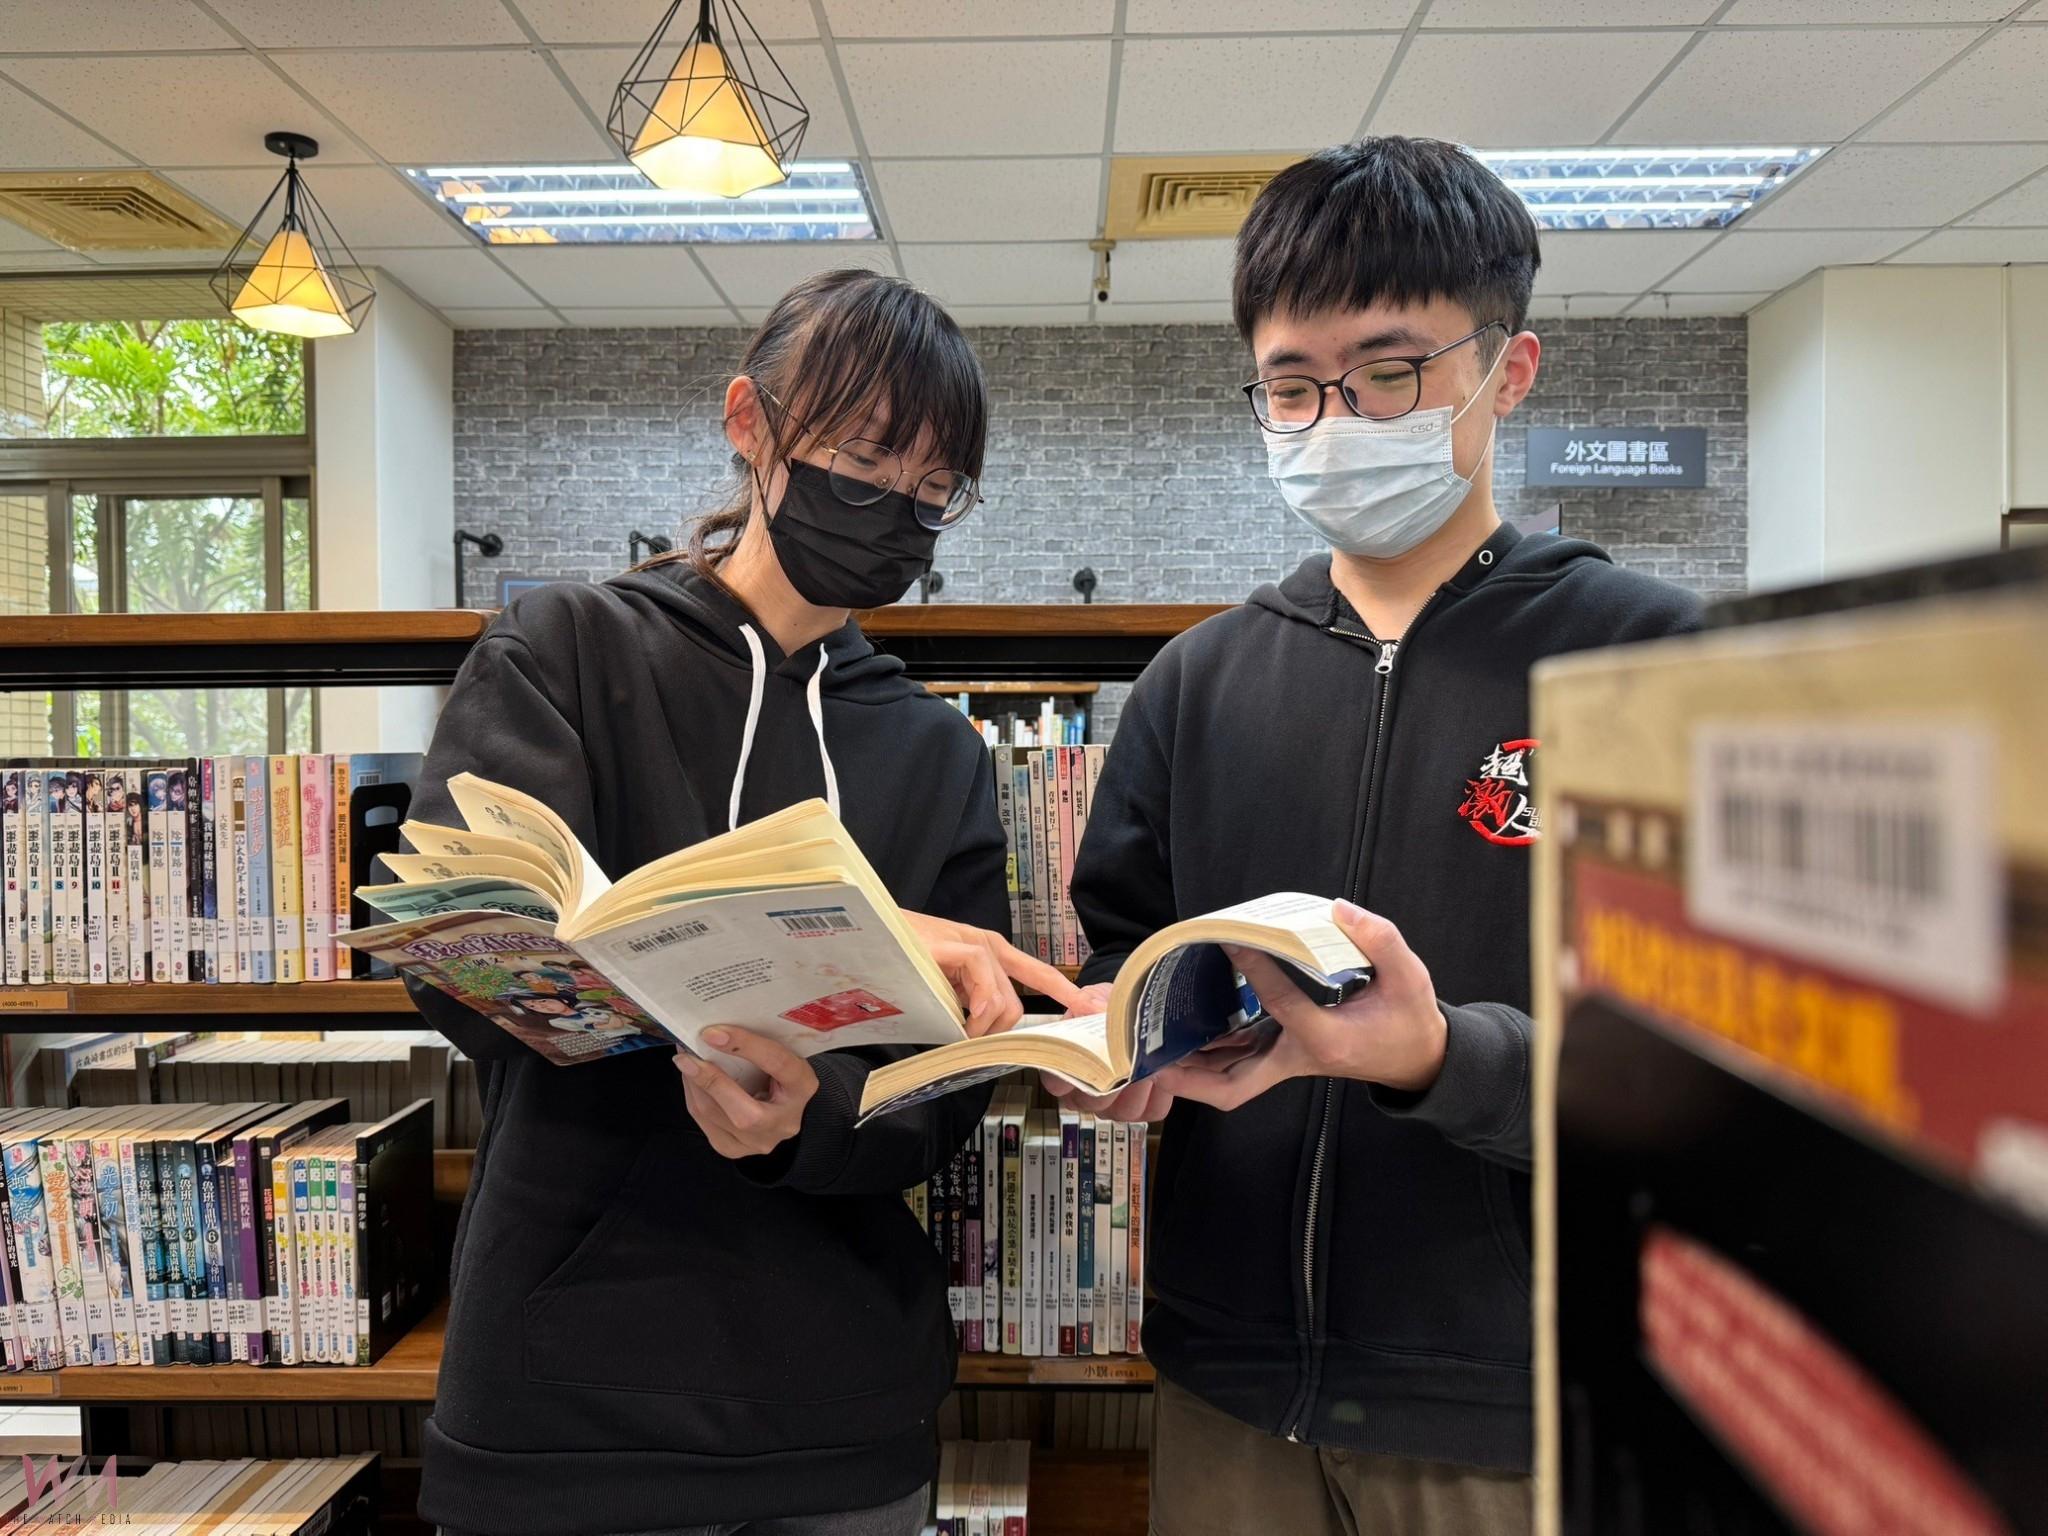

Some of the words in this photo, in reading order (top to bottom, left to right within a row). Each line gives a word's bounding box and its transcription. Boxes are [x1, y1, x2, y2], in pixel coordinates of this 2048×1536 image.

[1564, 439, 1669, 463] 外文圖書區
[1550, 462, 1592, 477] Foreign
[1593, 463, 1648, 478] Language
[1649, 463, 1683, 476] Books
